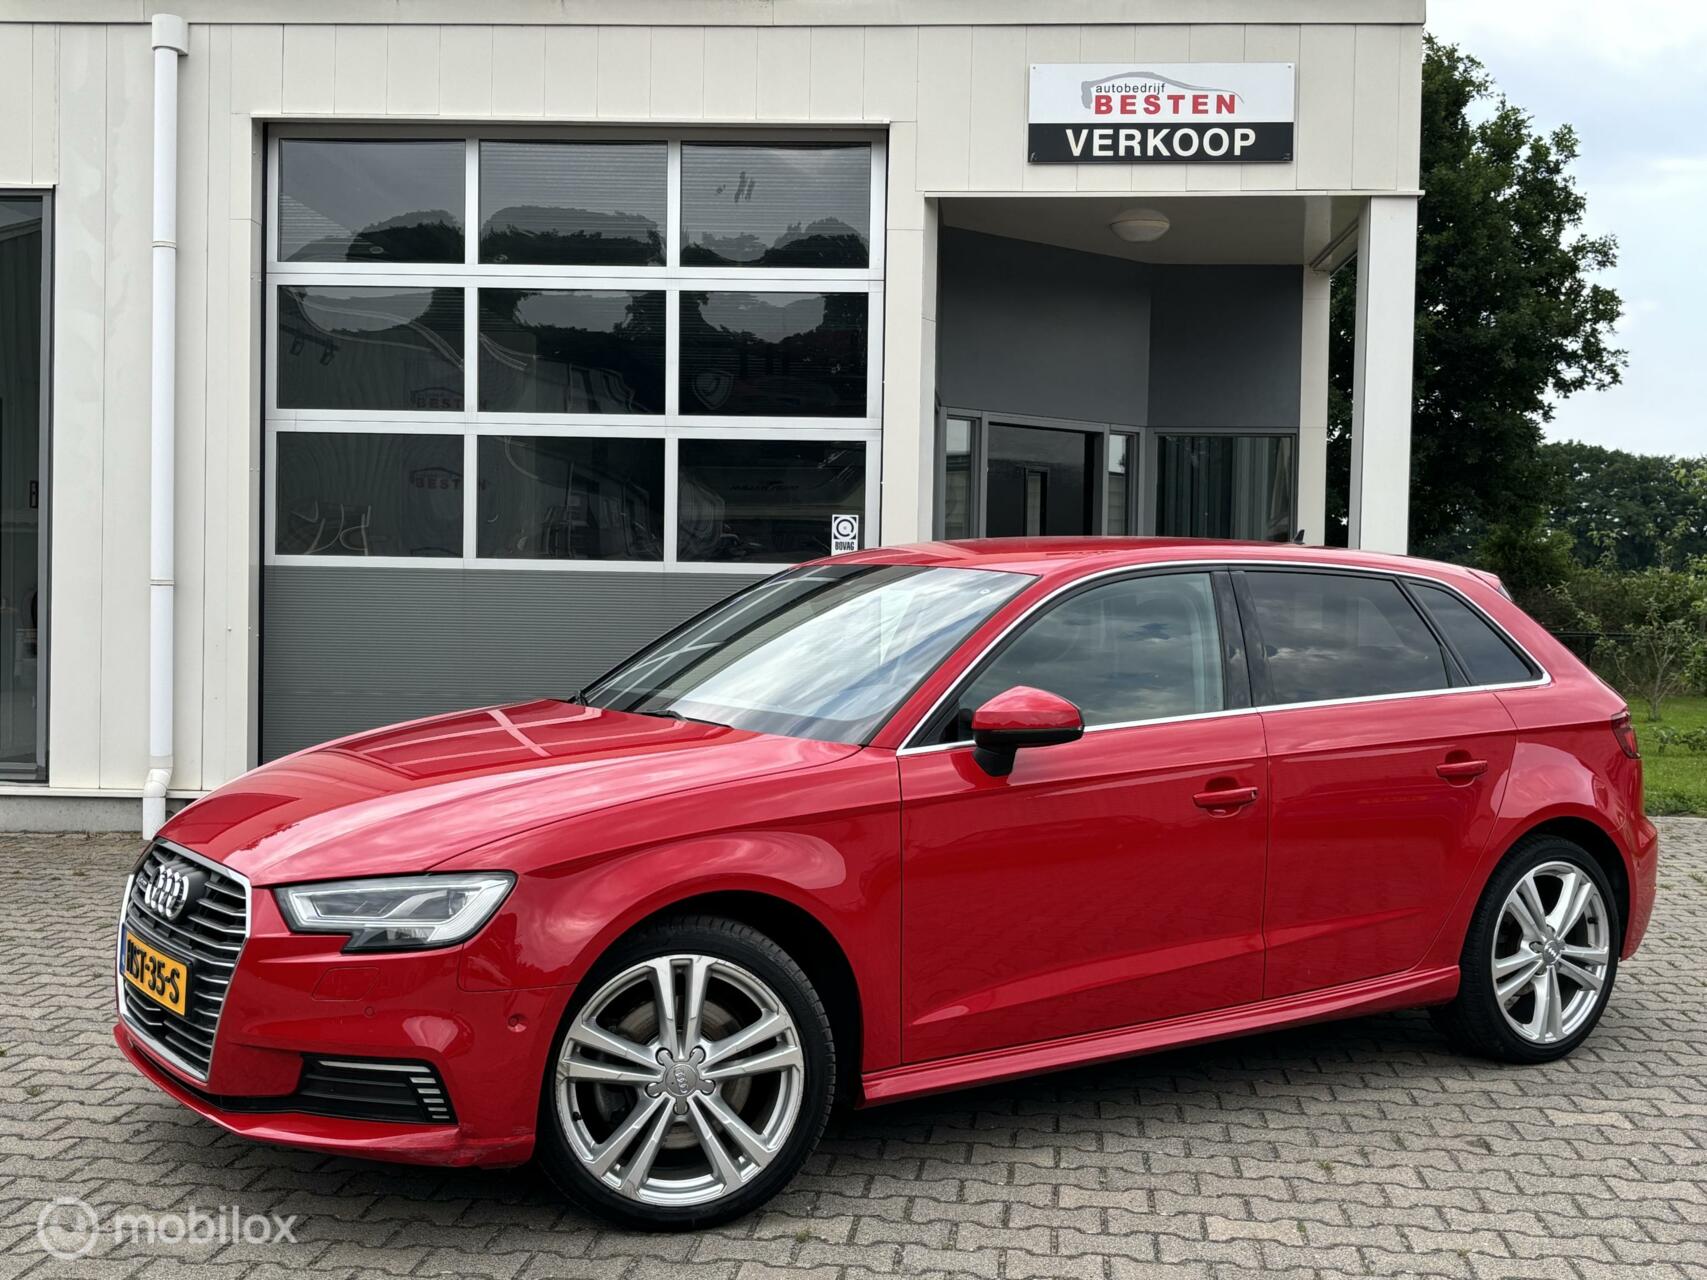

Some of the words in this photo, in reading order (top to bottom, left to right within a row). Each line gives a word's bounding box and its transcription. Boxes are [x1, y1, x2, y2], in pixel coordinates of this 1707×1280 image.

[1095, 82, 1166, 96] autobedrijf
[1094, 94, 1236, 115] BESTEN
[1065, 127, 1257, 157] VERKOOP
[416, 398, 488, 410] BESTN
[415, 478, 487, 490] BESTN
[834, 541, 855, 551] BOVAG
